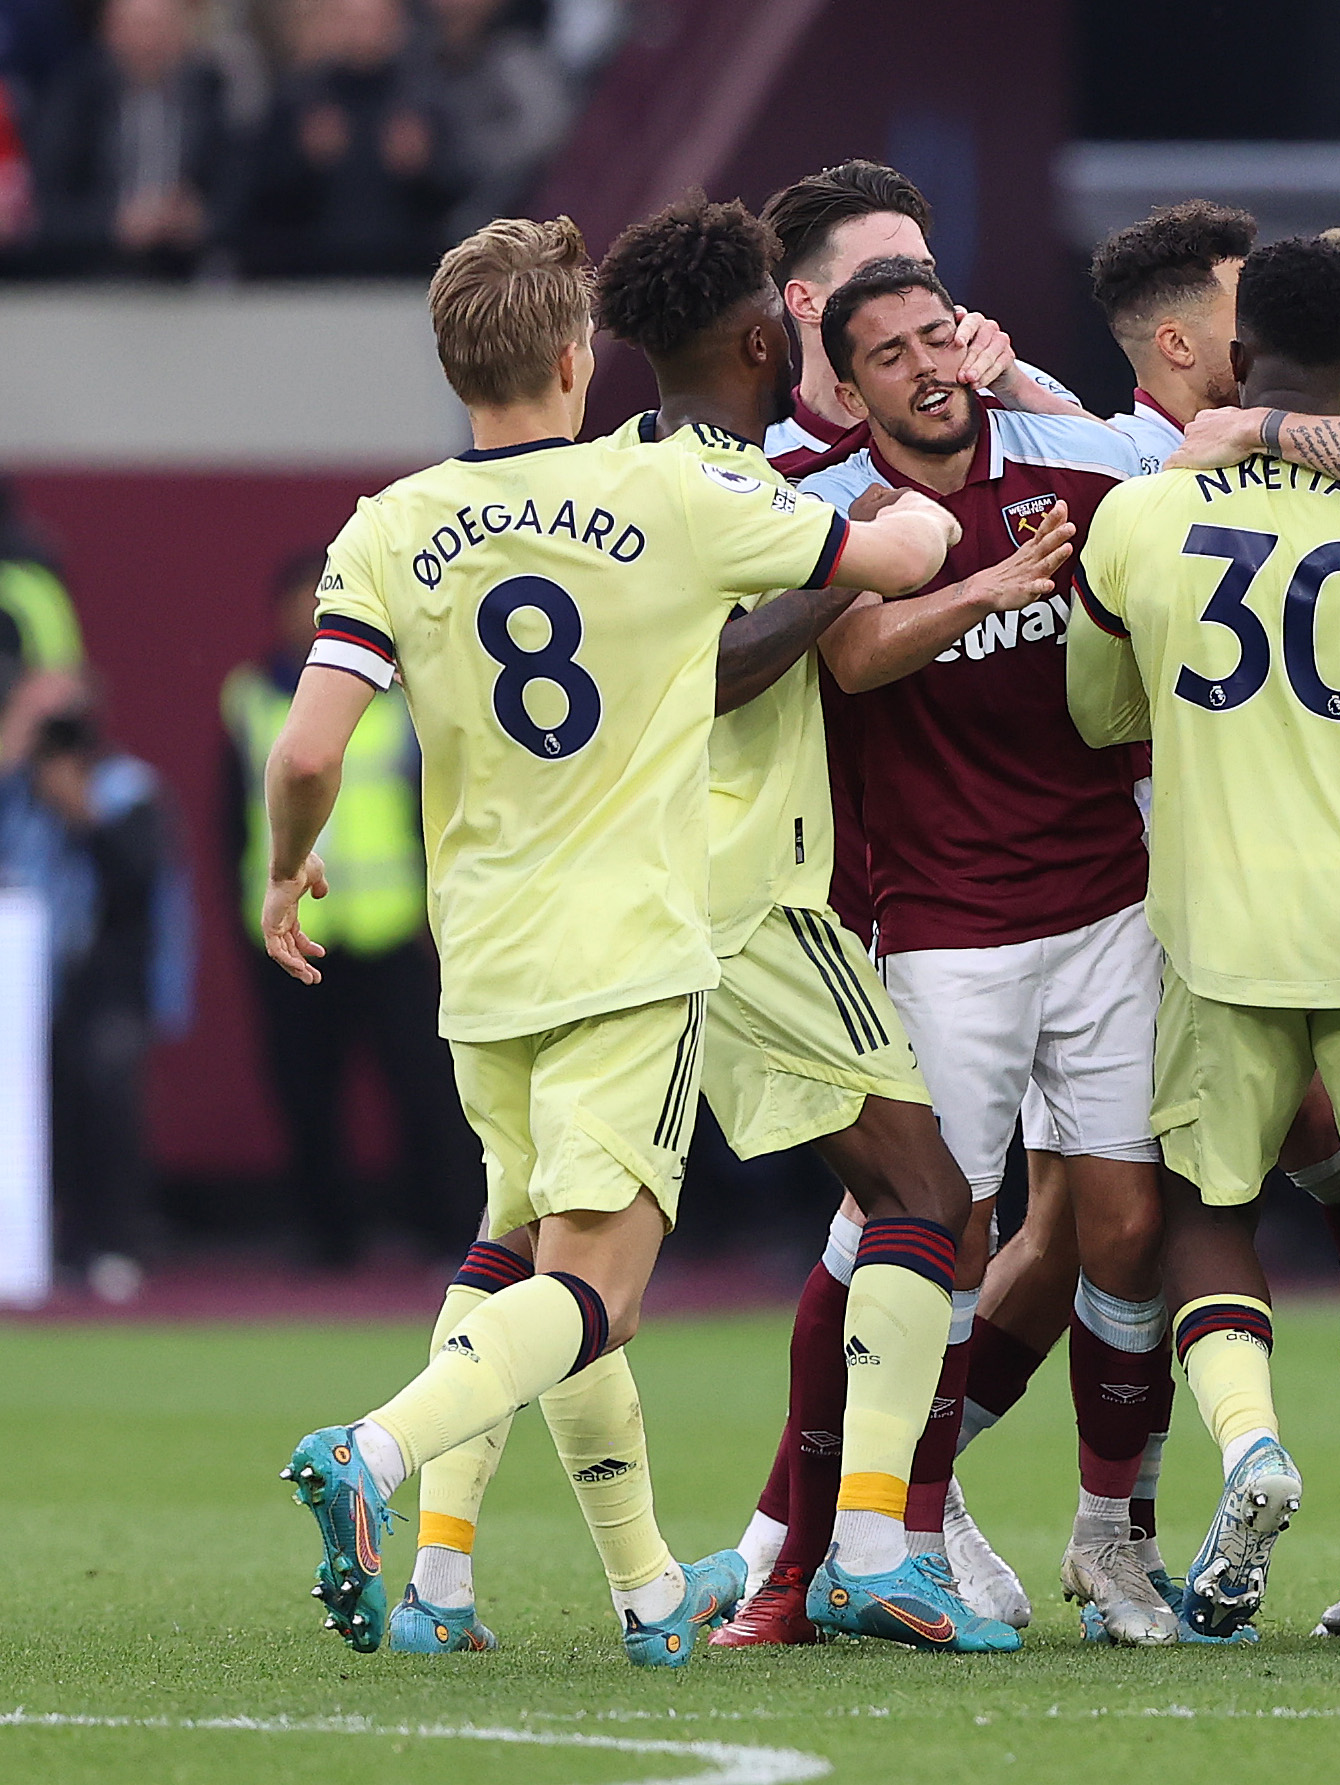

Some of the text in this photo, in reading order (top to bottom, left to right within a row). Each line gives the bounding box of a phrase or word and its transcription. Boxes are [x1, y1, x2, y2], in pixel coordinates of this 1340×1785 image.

[1008, 497, 1053, 515] WEST HAM
[412, 498, 646, 591] ØDEGAARD
[475, 574, 603, 762] 8
[572, 1460, 638, 1482] adidas
